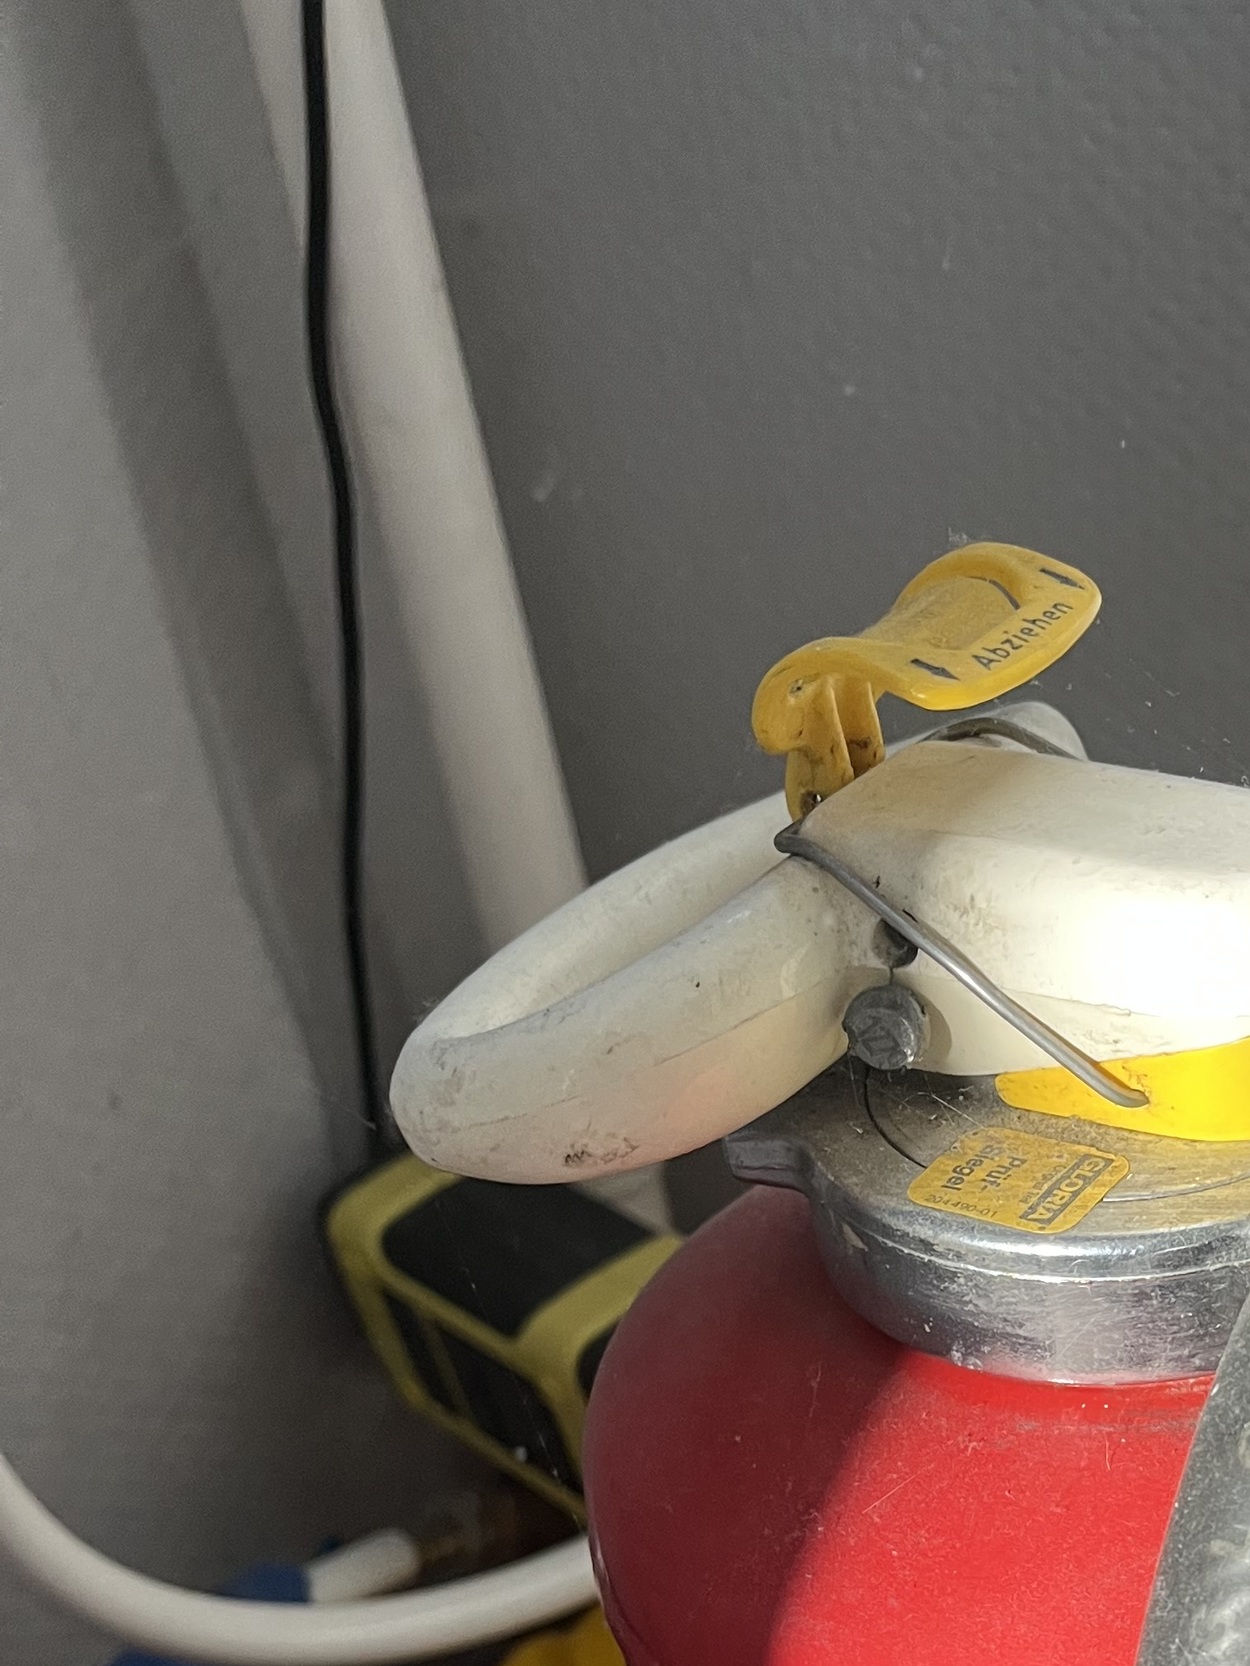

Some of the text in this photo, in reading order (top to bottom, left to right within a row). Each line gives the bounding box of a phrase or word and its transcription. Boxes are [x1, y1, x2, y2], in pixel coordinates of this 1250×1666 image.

[971, 602, 1074, 672] Abziehen
[941, 1144, 1001, 1192] Siegel
[981, 1156, 1027, 1192] Prüf-
[1026, 1156, 1107, 1222] GLORIA
